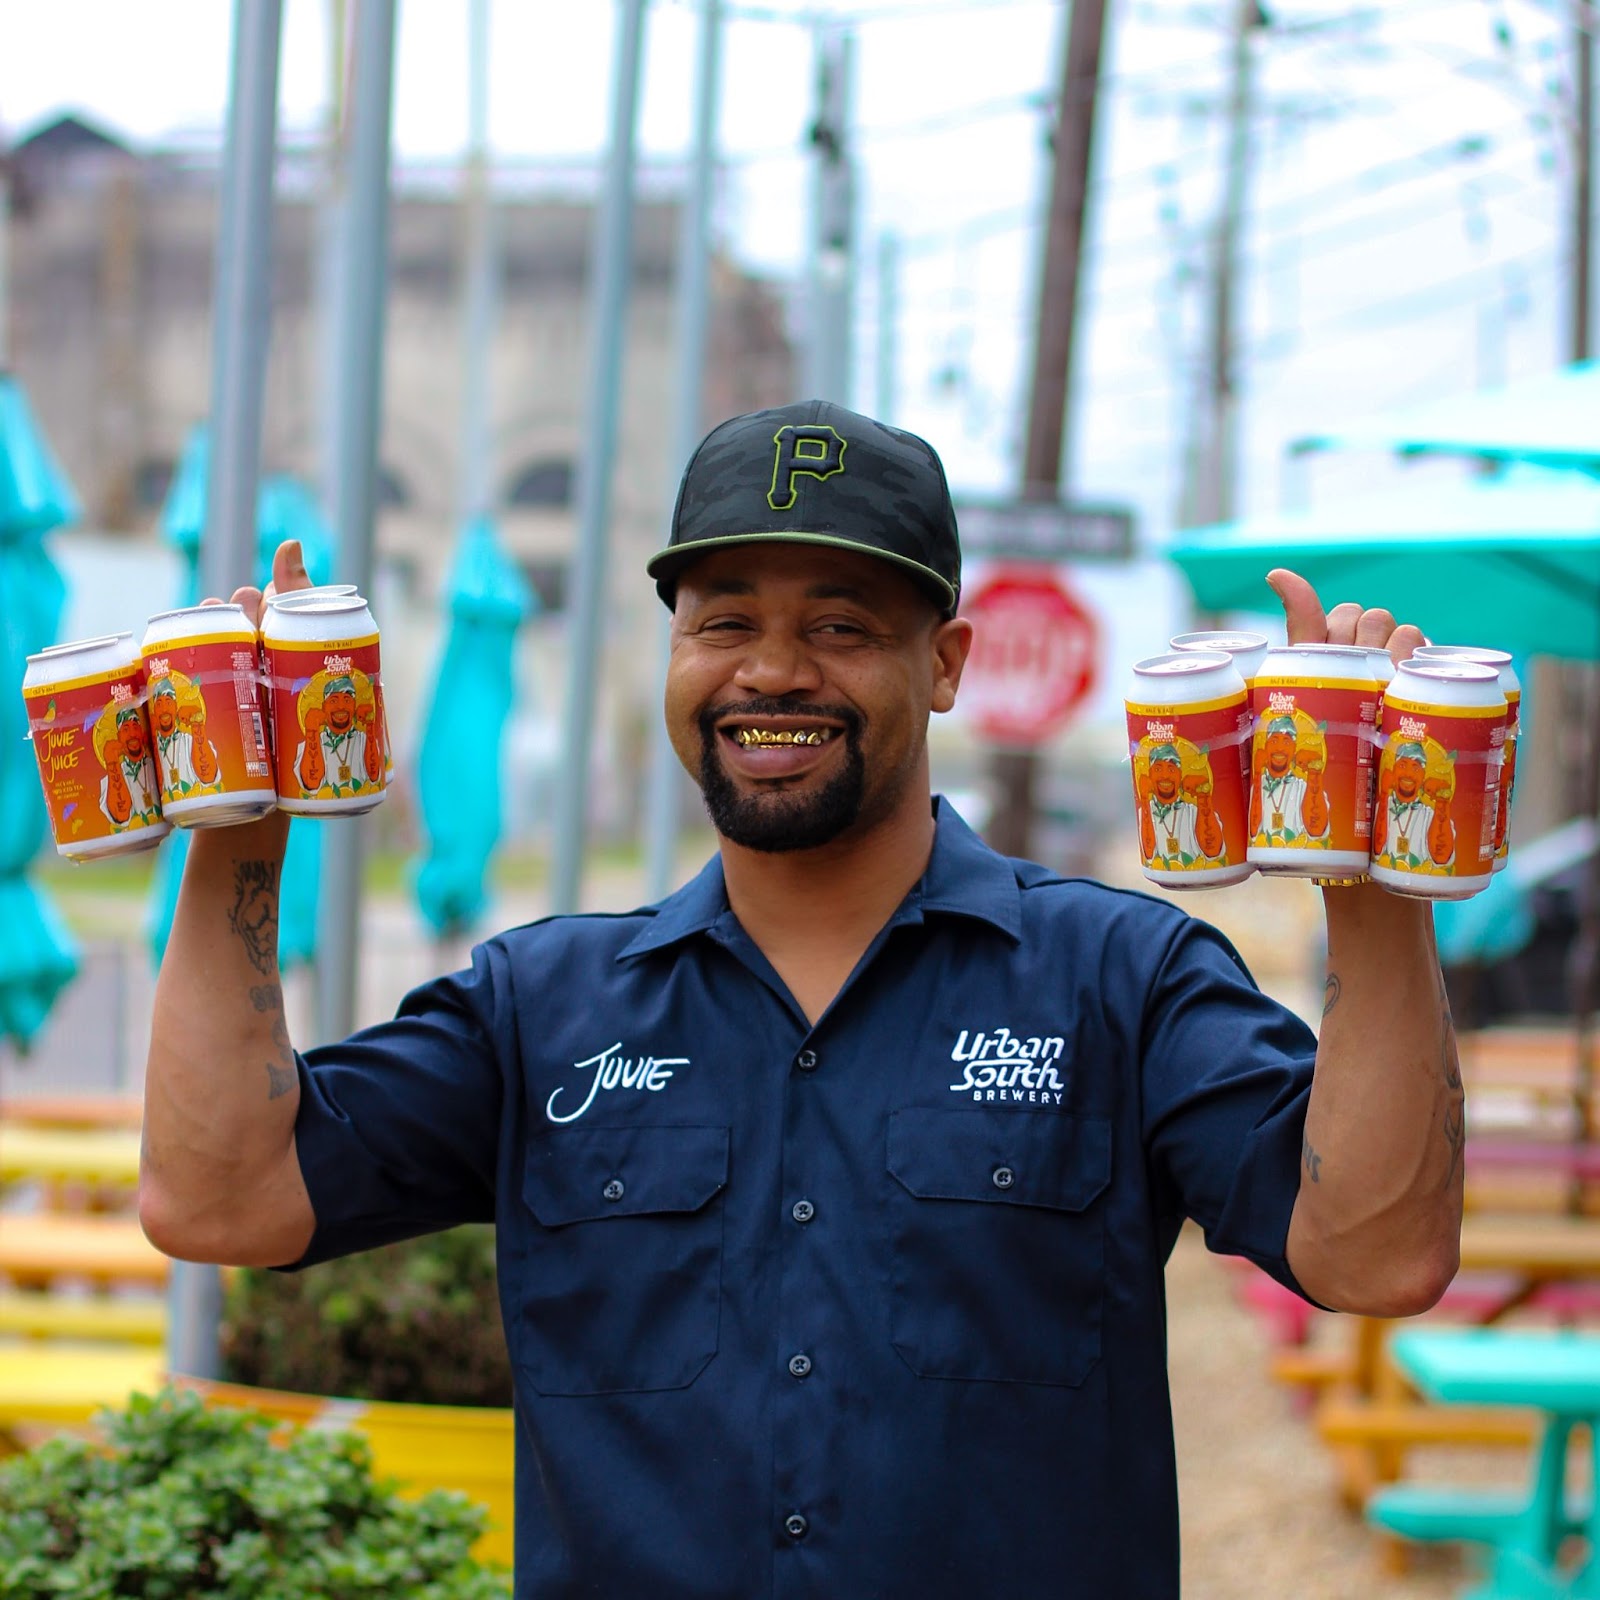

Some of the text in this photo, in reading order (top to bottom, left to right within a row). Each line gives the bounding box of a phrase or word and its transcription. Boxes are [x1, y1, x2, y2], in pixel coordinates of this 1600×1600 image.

[767, 424, 848, 510] P
[323, 654, 352, 665] Urban
[325, 662, 352, 673] South
[1269, 691, 1295, 702] Urban
[1269, 700, 1295, 711] South
[1146, 720, 1174, 731] Urban
[1399, 715, 1426, 729] Urban
[1148, 729, 1174, 739] South
[40, 727, 80, 763] JUVIE
[46, 746, 85, 783] JUICE
[951, 1027, 1065, 1062] Urban
[949, 1057, 1065, 1091] South
[546, 1042, 691, 1123] JUVIE
[973, 1089, 1062, 1105] BREWERY
